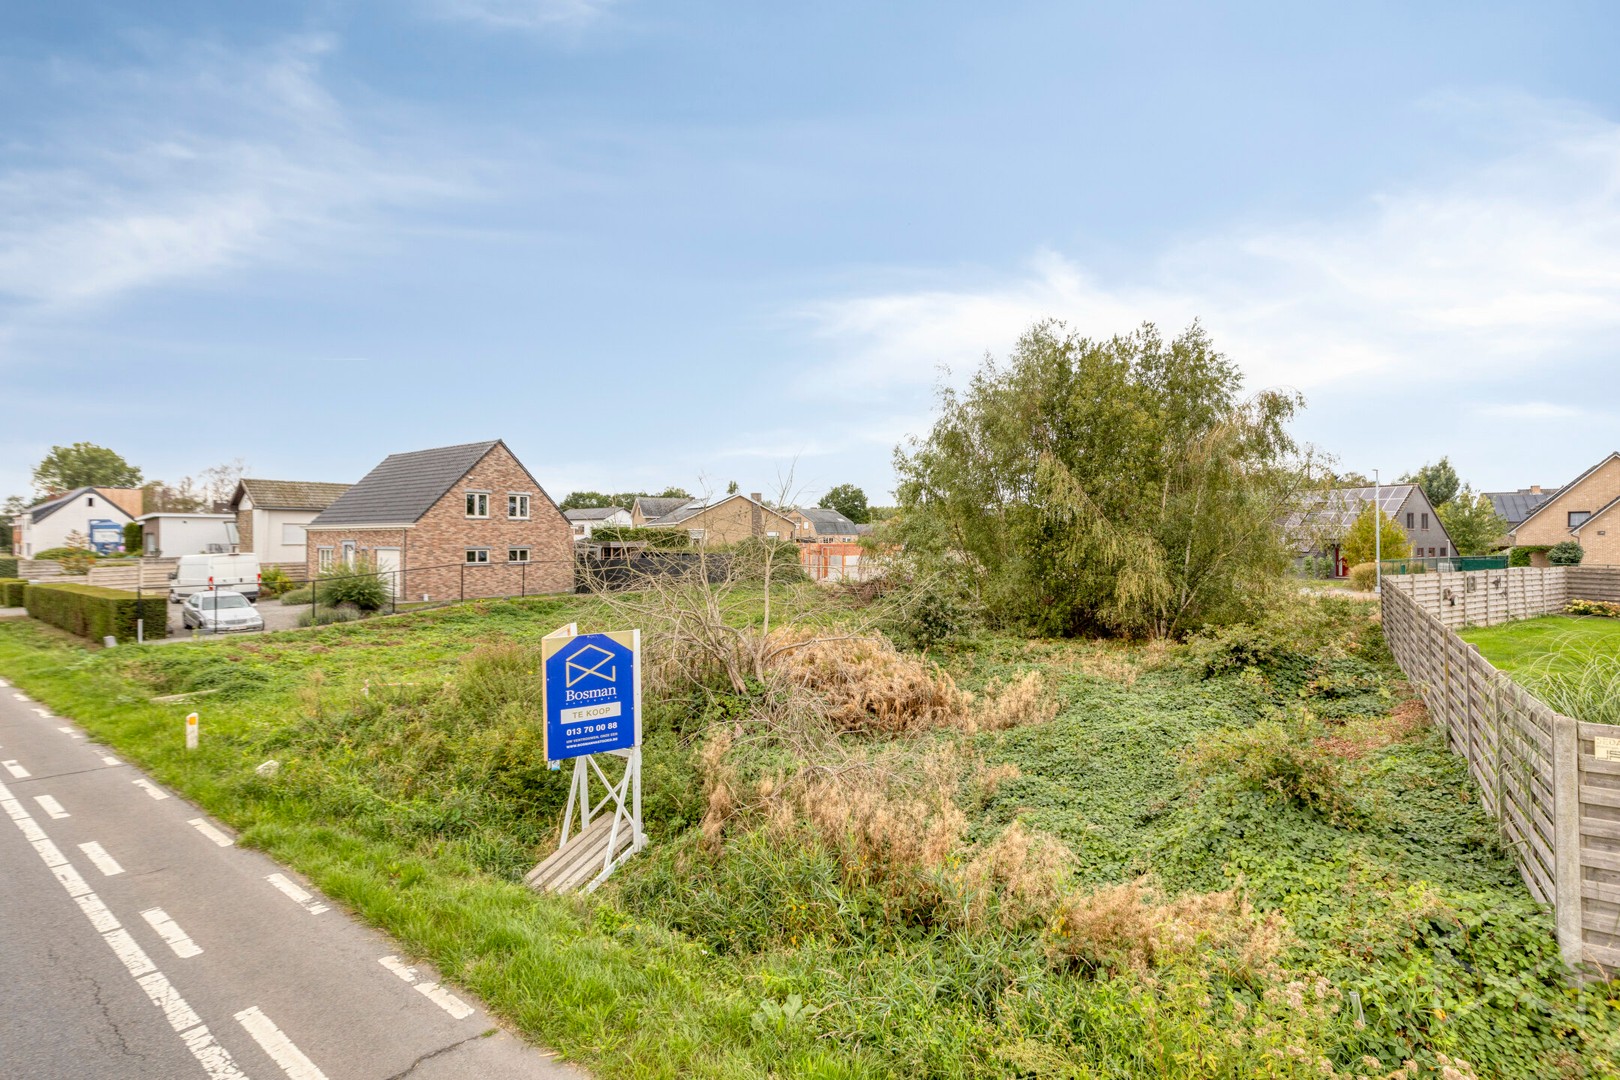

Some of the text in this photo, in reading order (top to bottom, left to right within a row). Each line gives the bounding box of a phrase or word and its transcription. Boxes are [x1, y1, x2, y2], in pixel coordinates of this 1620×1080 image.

[566, 686, 617, 702] Bosman
[586, 707, 610, 717] KOOP
[566, 728, 582, 736] 013
